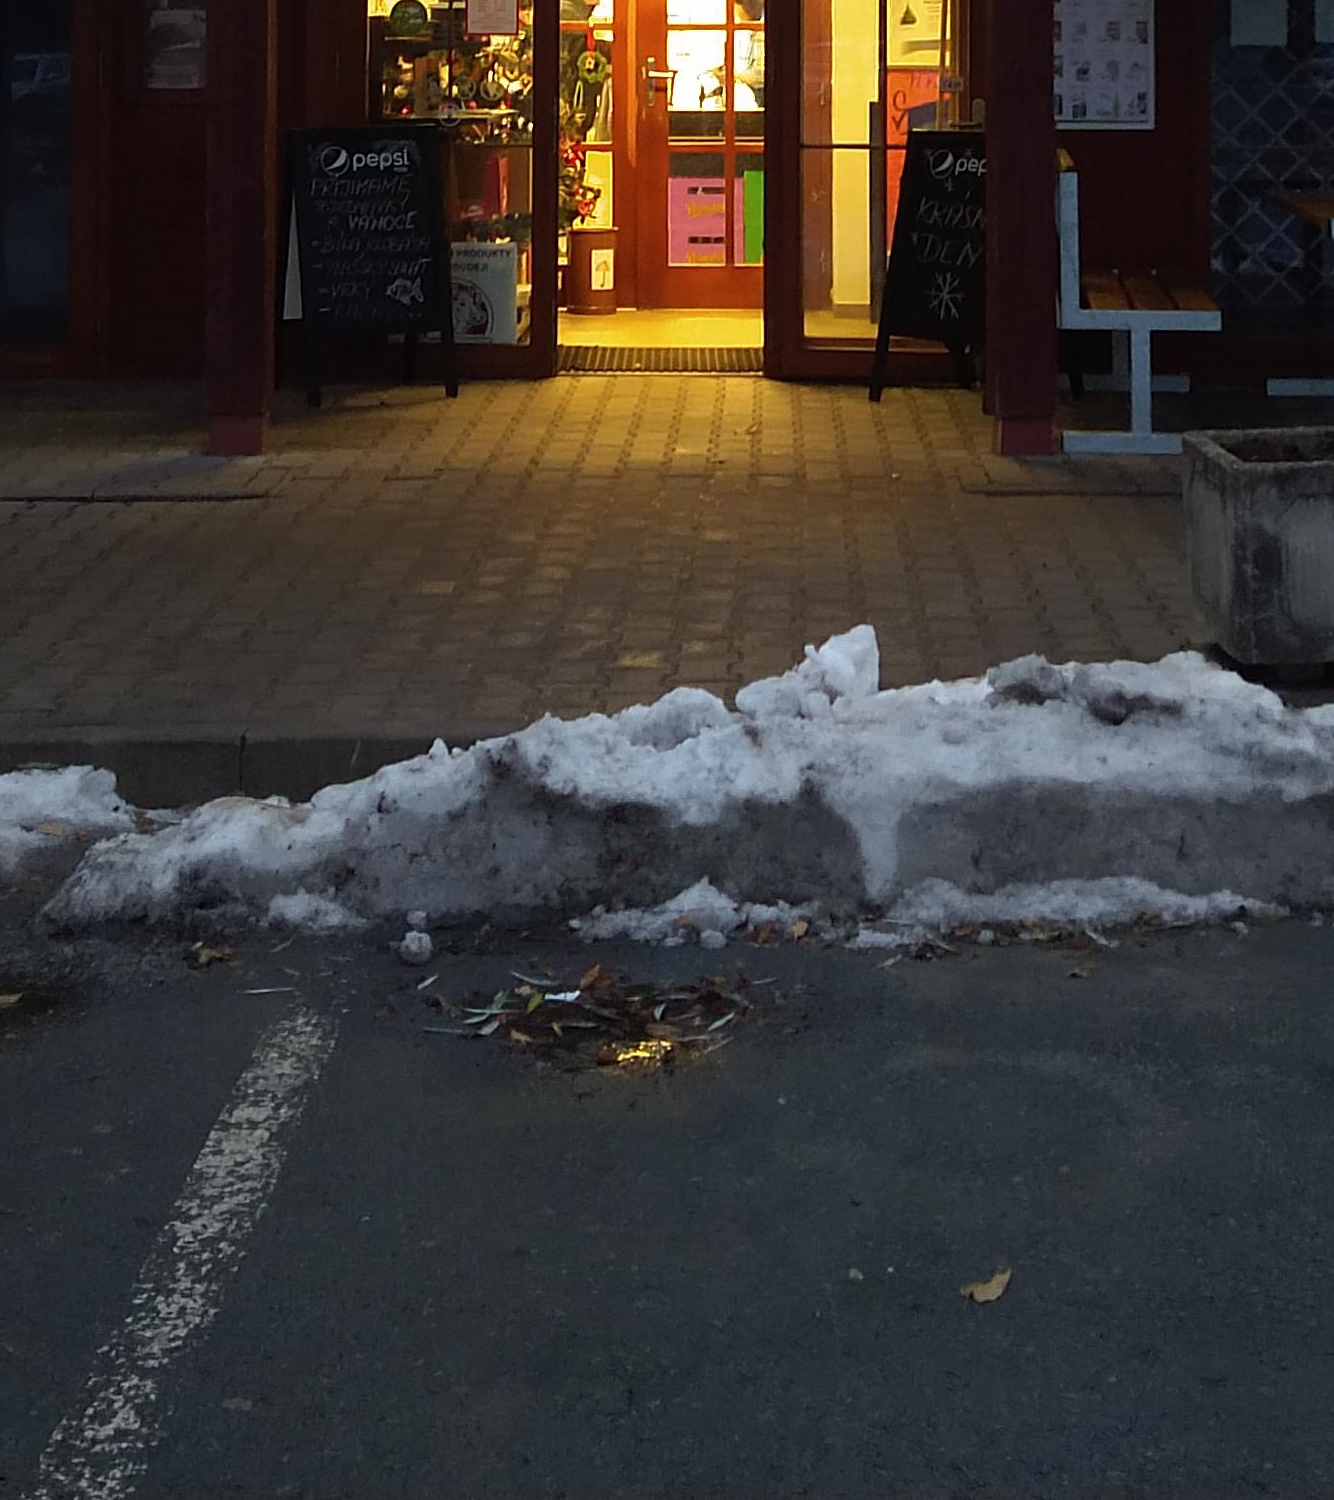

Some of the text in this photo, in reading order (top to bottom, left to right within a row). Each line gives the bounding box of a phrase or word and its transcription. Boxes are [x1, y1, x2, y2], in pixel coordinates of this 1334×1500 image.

[352, 148, 411, 172] pepsi
[955, 157, 987, 177] pep
[455, 248, 511, 258] PRODUKTY
[453, 261, 488, 271] RODEJI
